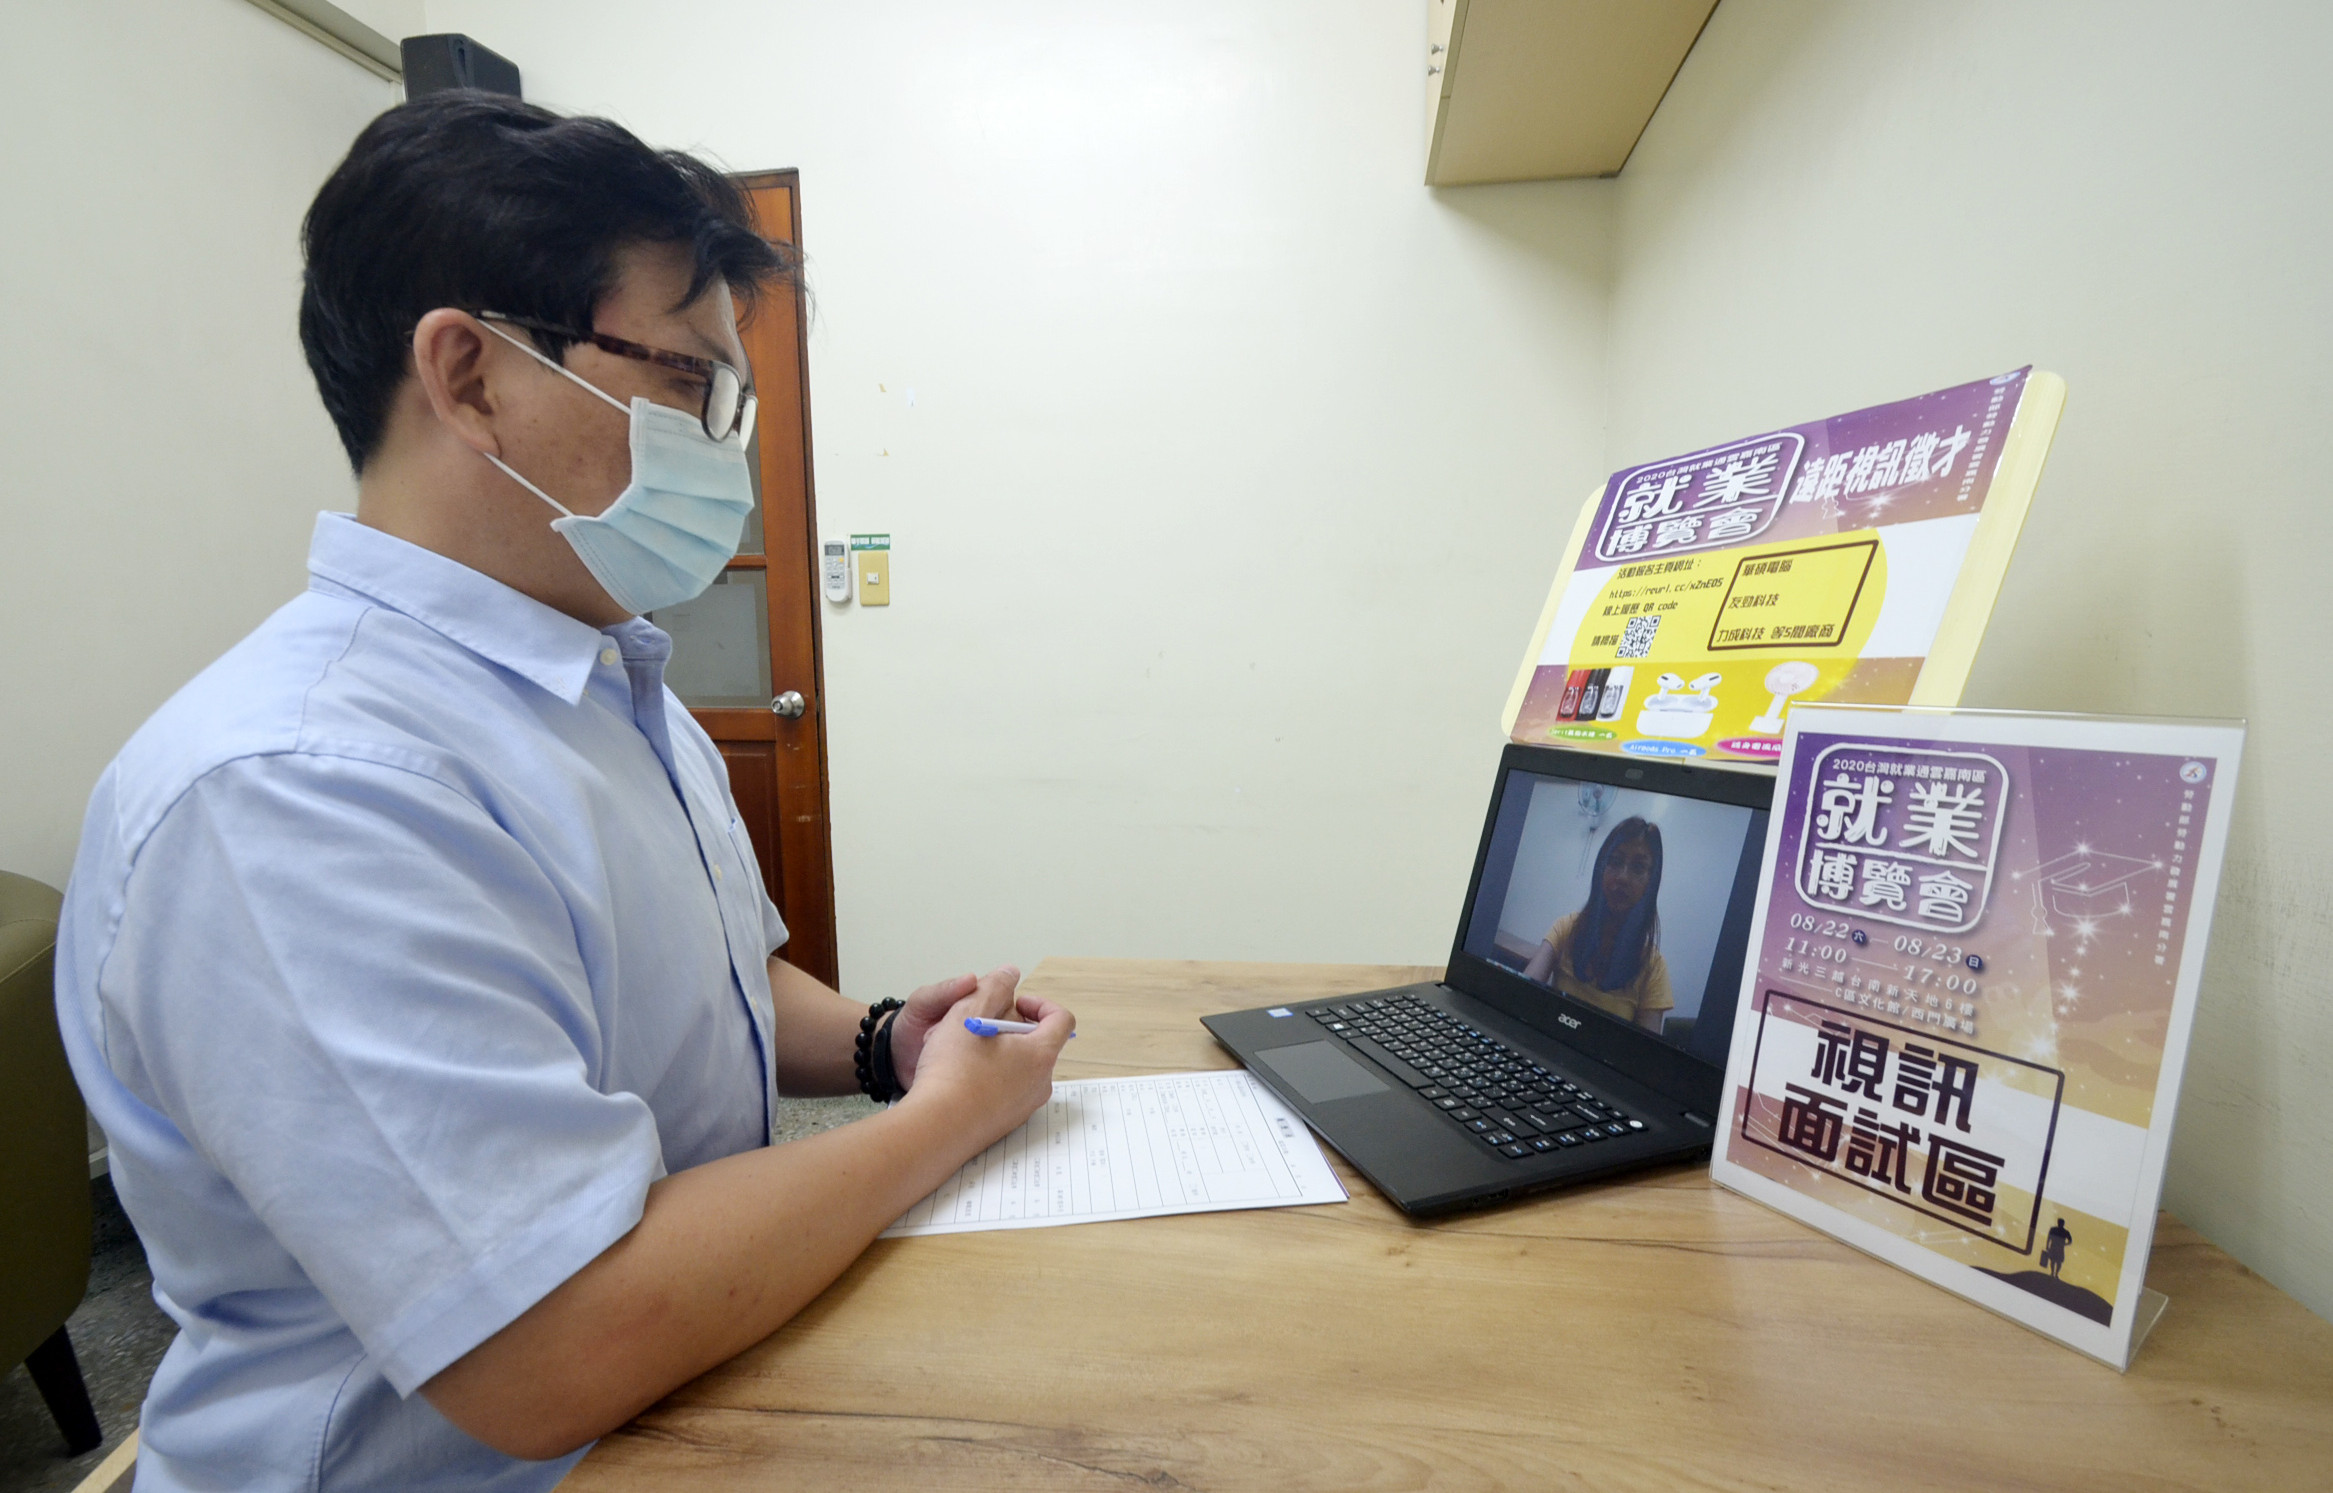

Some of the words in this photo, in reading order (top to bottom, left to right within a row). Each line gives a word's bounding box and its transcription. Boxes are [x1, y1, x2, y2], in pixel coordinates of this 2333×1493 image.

[1619, 453, 1779, 523] 就業
[1789, 424, 1972, 504] 遠距視訊徵才
[1606, 507, 1763, 556] 博覽會
[1643, 602, 1655, 613] QR
[1657, 600, 1679, 611] code
[1716, 627, 1766, 643] 力成科技
[1833, 758, 1987, 784] 2020台灣就業通雲嘉南區
[1816, 772, 1985, 858] 就業
[1807, 849, 1974, 923] 博覽會
[1785, 936, 1847, 964] 11:00
[1903, 964, 1977, 995] 17:00
[1790, 912, 1850, 940] 08/22
[1894, 935, 1963, 965] 08/23
[1558, 1012, 1582, 1030] acer
[1811, 1020, 1979, 1133] 視訊
[1777, 1082, 2006, 1227] 面試區
